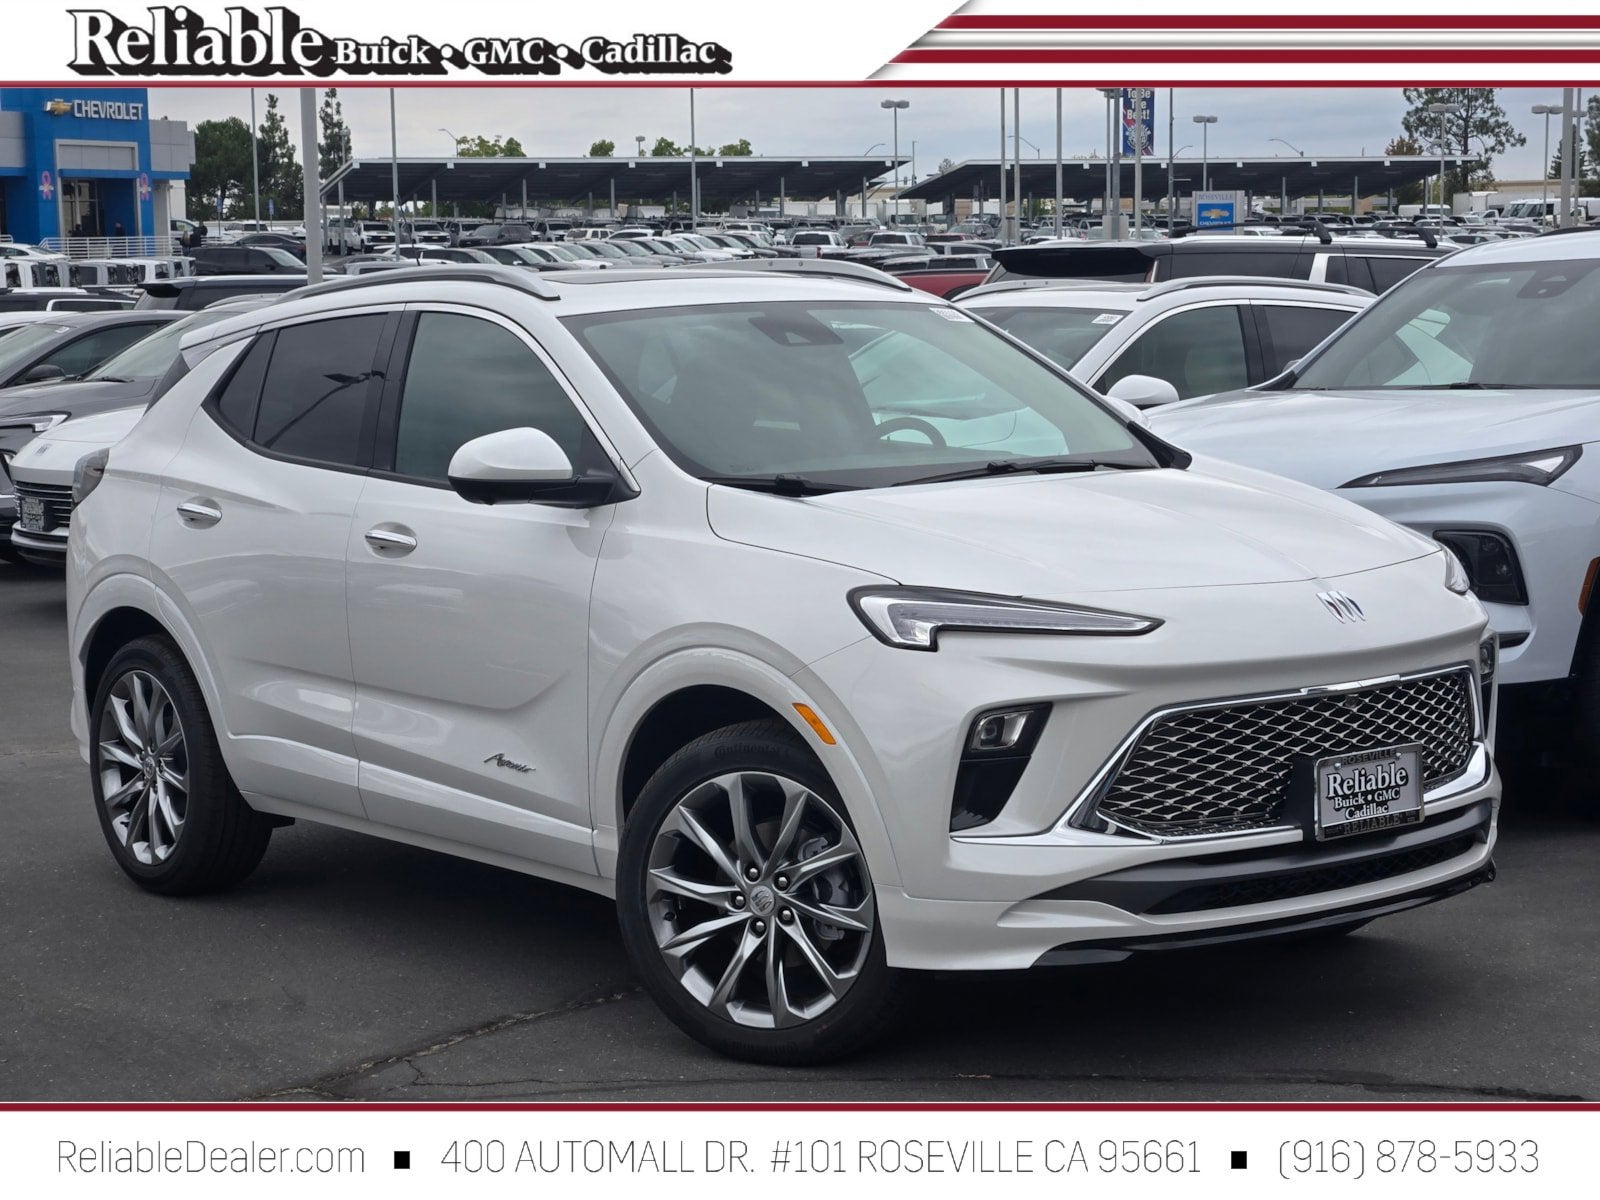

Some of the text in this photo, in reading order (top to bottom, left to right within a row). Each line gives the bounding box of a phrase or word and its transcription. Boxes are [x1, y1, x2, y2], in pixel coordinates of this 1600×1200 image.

[74, 99, 143, 121] CHEVROLET
[1130, 98, 1147, 109] Te
[1127, 109, 1150, 120] Bet!
[1342, 748, 1397, 766] ROSEVILLE
[1326, 762, 1409, 799] Reliable
[1334, 786, 1401, 810] Buick GMC
[1345, 803, 1389, 820] Cadillac
